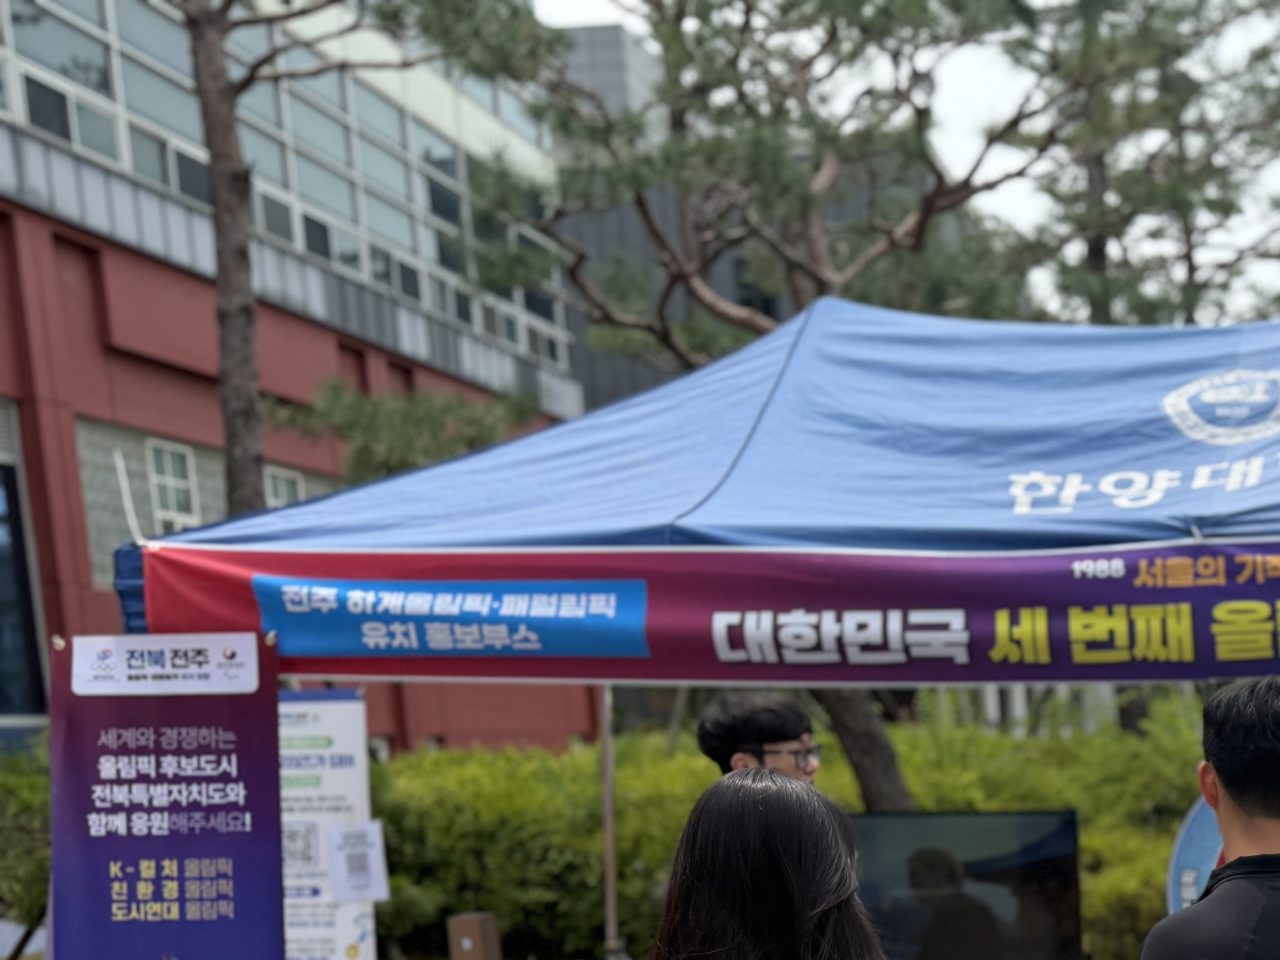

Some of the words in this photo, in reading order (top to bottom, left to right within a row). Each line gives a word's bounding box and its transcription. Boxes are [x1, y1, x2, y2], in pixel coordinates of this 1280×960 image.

[1071, 557, 1126, 580] 1988
[1133, 556, 1227, 590] 서울의
[281, 583, 340, 614] 전주
[346, 587, 618, 620] 하계올림픽·패럴림픽
[361, 620, 419, 650] 유치
[425, 621, 543, 651] 홍보부스
[711, 607, 971, 667] 대한민국
[988, 602, 1053, 666] 세
[1067, 601, 1196, 666] 번째
[125, 648, 166, 670] 전북
[169, 647, 210, 669] 전주
[97, 726, 156, 750] 세계와
[159, 726, 238, 749] 경쟁하는
[97, 753, 157, 780] 올림픽
[159, 752, 238, 779] 후보도시
[90, 781, 248, 809] 전북특별자치도와
[86, 812, 128, 837] 함께
[129, 811, 253, 837] 응원해주세요!
[183, 857, 234, 879] 올림픽
[184, 878, 234, 899] 올림픽
[111, 900, 180, 922] 도시연대
[184, 900, 235, 921] 올림픽
